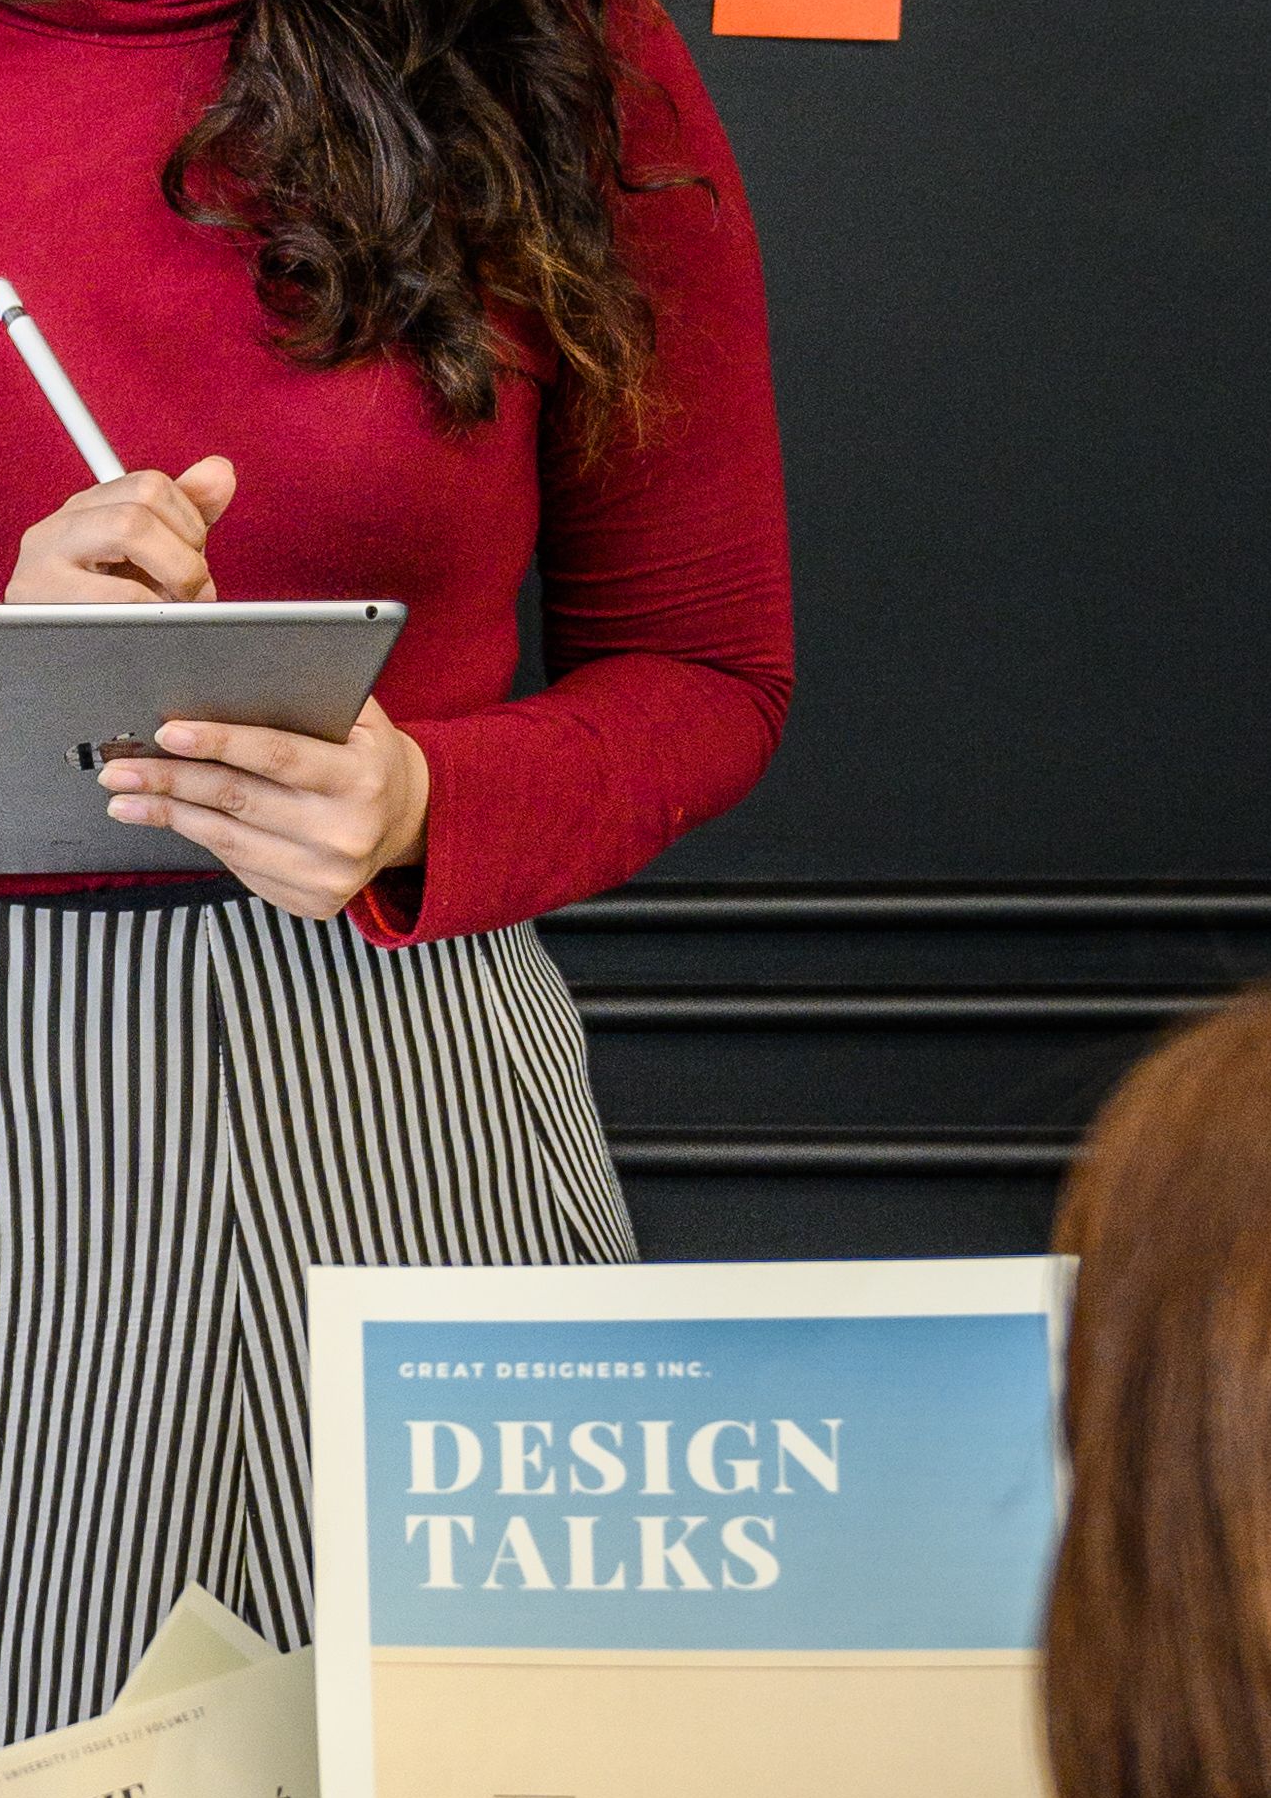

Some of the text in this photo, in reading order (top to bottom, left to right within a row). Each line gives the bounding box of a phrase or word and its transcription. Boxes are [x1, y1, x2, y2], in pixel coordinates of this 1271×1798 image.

[398, 1360, 712, 1380] GREAT DESIGNERS INC.
[403, 1418, 844, 1496] DESIGN
[405, 1513, 781, 1592] TALKS
